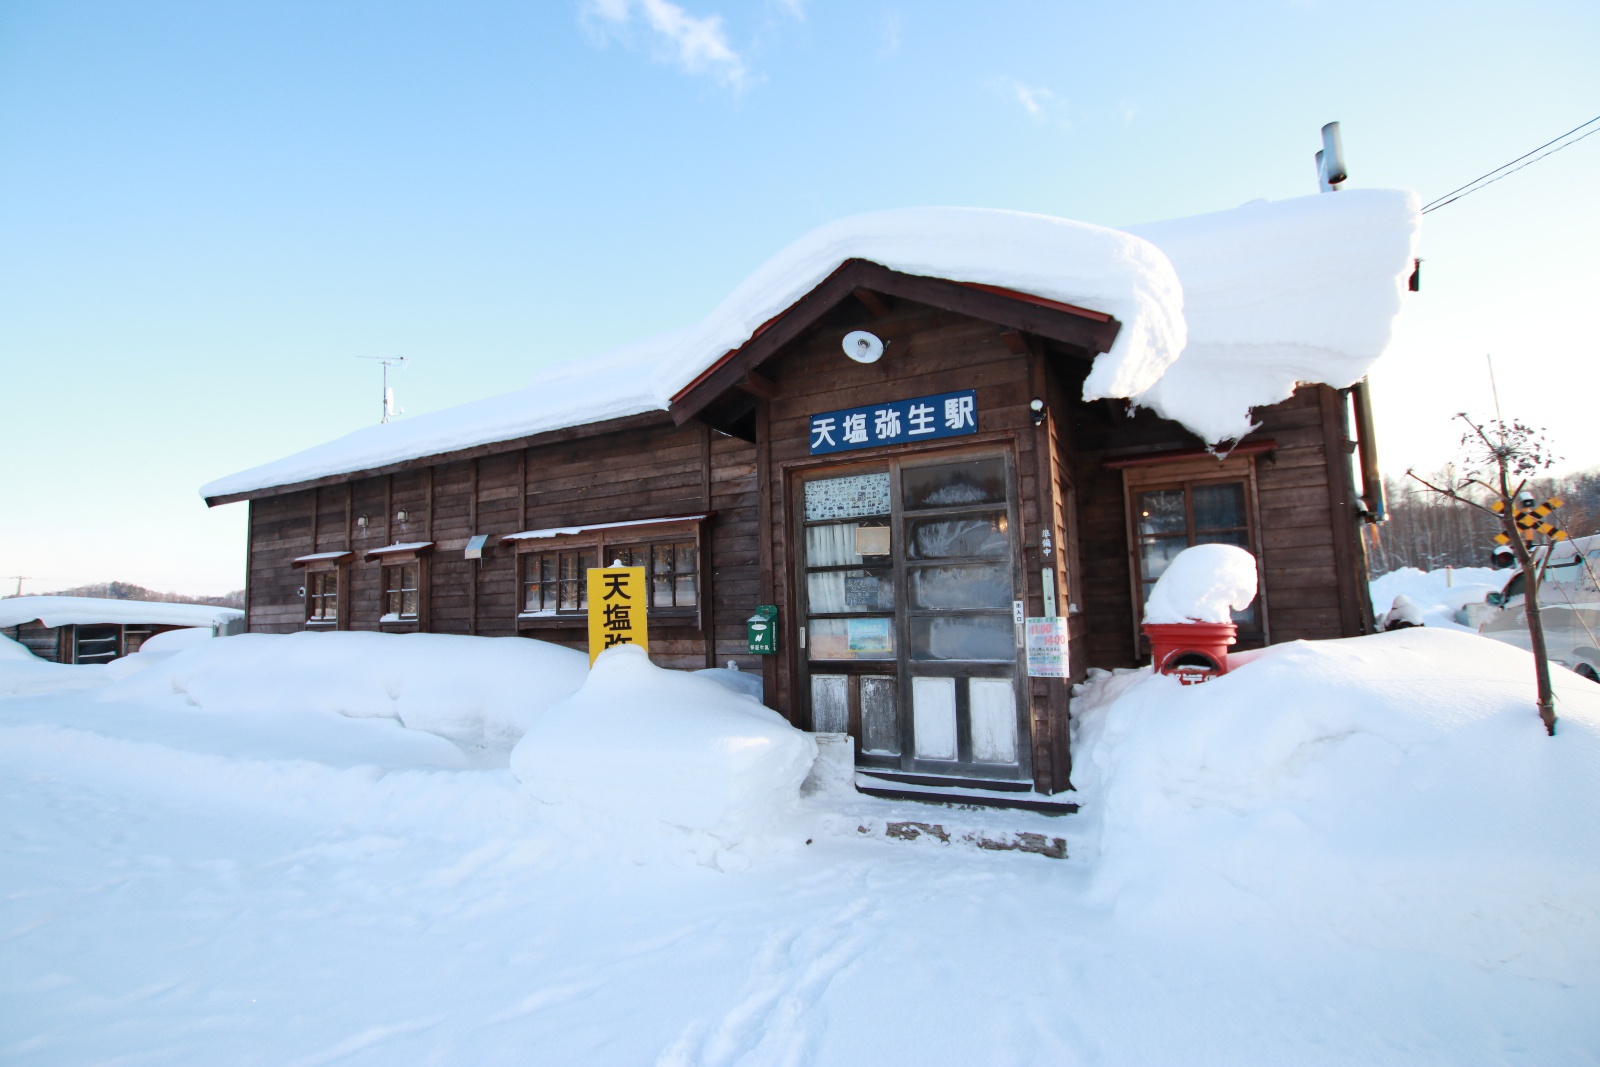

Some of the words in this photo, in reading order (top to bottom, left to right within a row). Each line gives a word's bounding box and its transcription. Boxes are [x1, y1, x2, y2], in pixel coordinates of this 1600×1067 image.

[811, 395, 975, 449] 天塩弥生駅
[1042, 529, 1052, 557] 準備中
